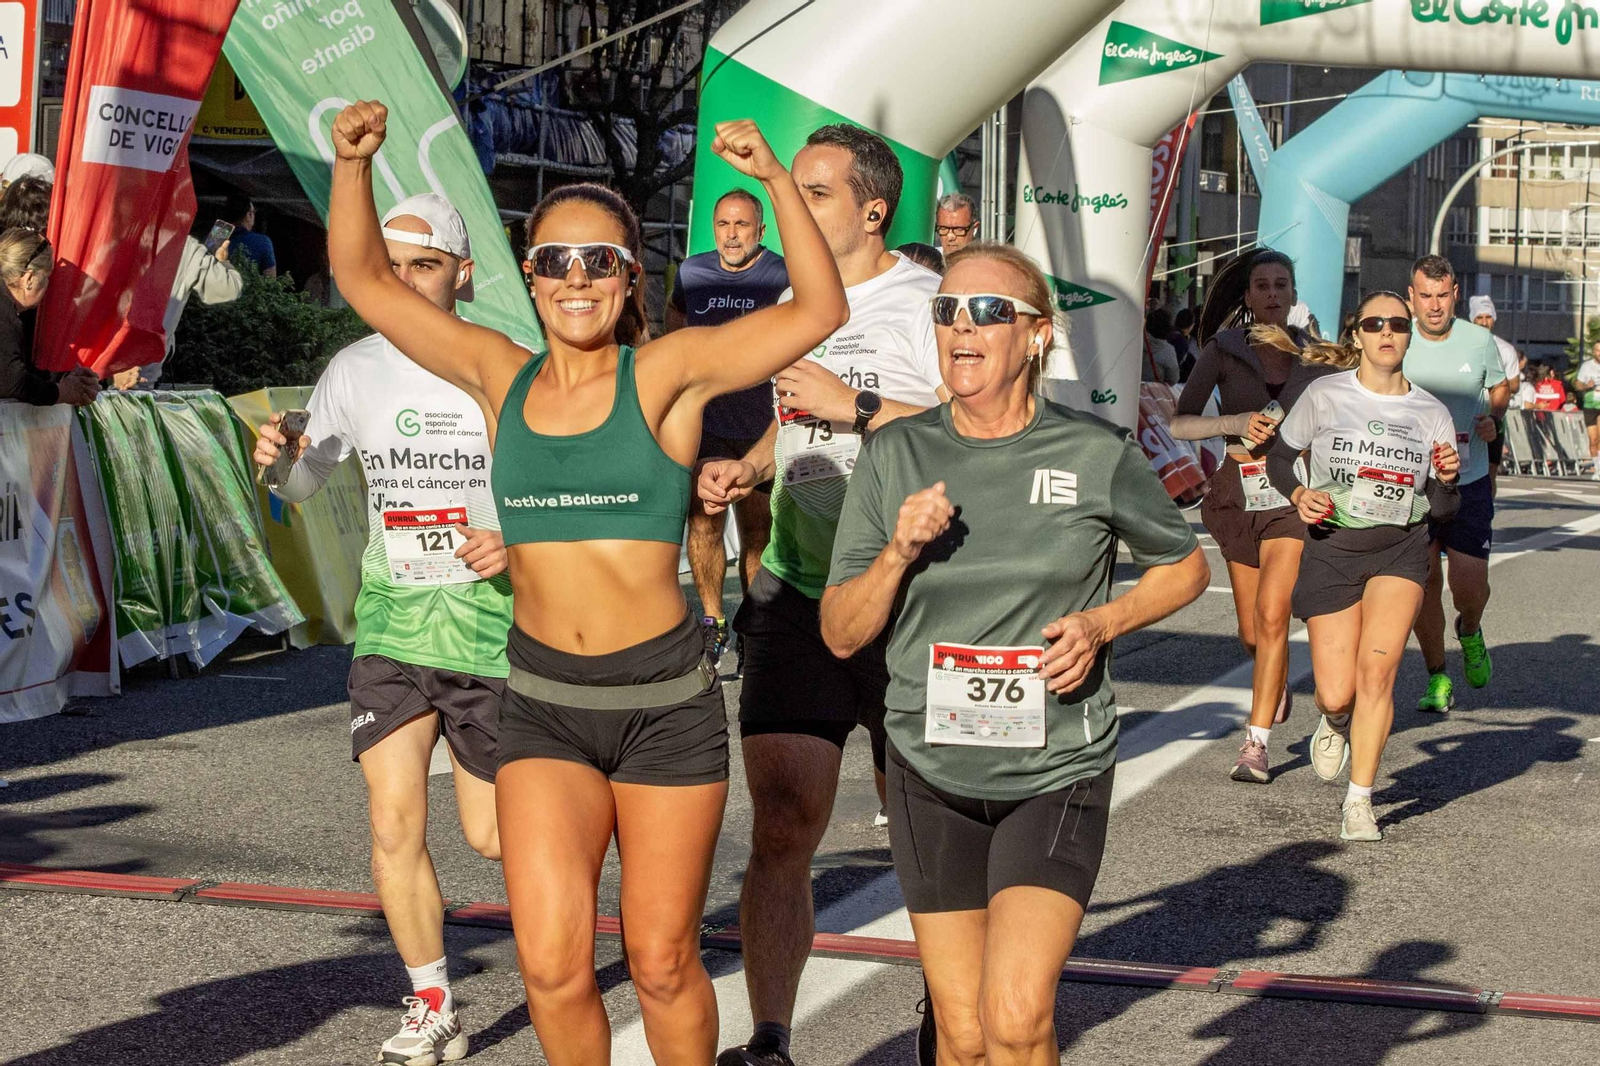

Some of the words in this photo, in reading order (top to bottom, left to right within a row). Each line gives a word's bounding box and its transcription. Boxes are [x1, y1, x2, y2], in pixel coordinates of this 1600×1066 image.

[1105, 42, 1117, 57] El
[1117, 43, 1149, 60] Corte
[1149, 41, 1197, 66] Inglés
[109, 129, 136, 149] DE
[1023, 184, 1033, 203] El
[1034, 186, 1069, 206] Corte
[1071, 183, 1128, 214] Inglés
[695, 294, 755, 315] galicia
[425, 411, 463, 420] asociación
[425, 420, 457, 428] española
[457, 429, 482, 437] cáncer
[804, 420, 833, 445] 73
[389, 447, 486, 471] Marcha
[1332, 436, 1353, 452] En
[1358, 440, 1423, 464] Marcha
[1329, 456, 1361, 466] contra
[401, 476, 415, 489] el
[417, 476, 466, 490] cáncer
[468, 478, 487, 488] en
[1329, 467, 1355, 487] Vig
[504, 495, 558, 508] Active
[559, 493, 639, 507] Balance
[1374, 484, 1406, 501] 329
[416, 530, 454, 552] 121
[967, 677, 1025, 703] 376
